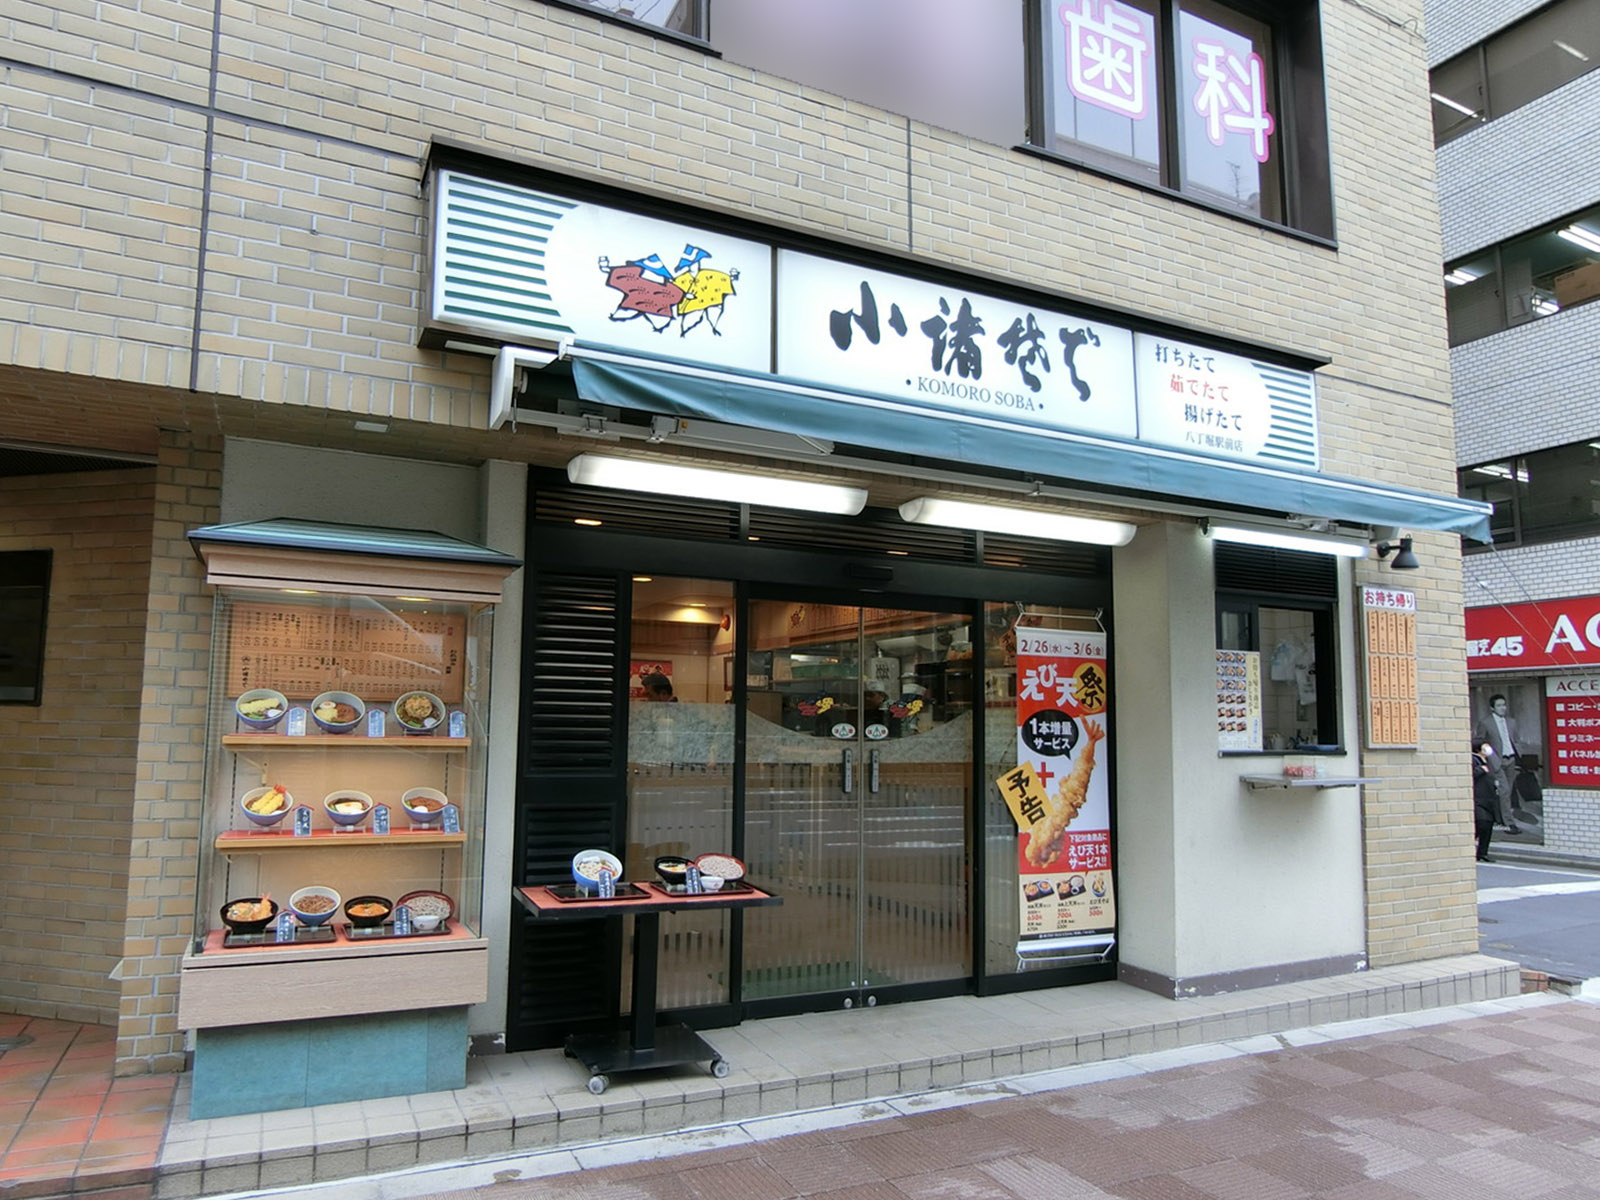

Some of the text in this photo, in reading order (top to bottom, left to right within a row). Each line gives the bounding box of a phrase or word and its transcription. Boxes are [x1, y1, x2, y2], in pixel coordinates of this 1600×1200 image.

[1155, 343, 1215, 373] 打ちたて
[917, 376, 1036, 412] KOMORO SOBA
[1170, 373, 1229, 402] 茹でたて
[1184, 403, 1243, 431] 揚げたて
[1365, 590, 1413, 608] お持ち帰り
[1033, 737, 1071, 750] サービス
[1007, 769, 1046, 824] 予告
